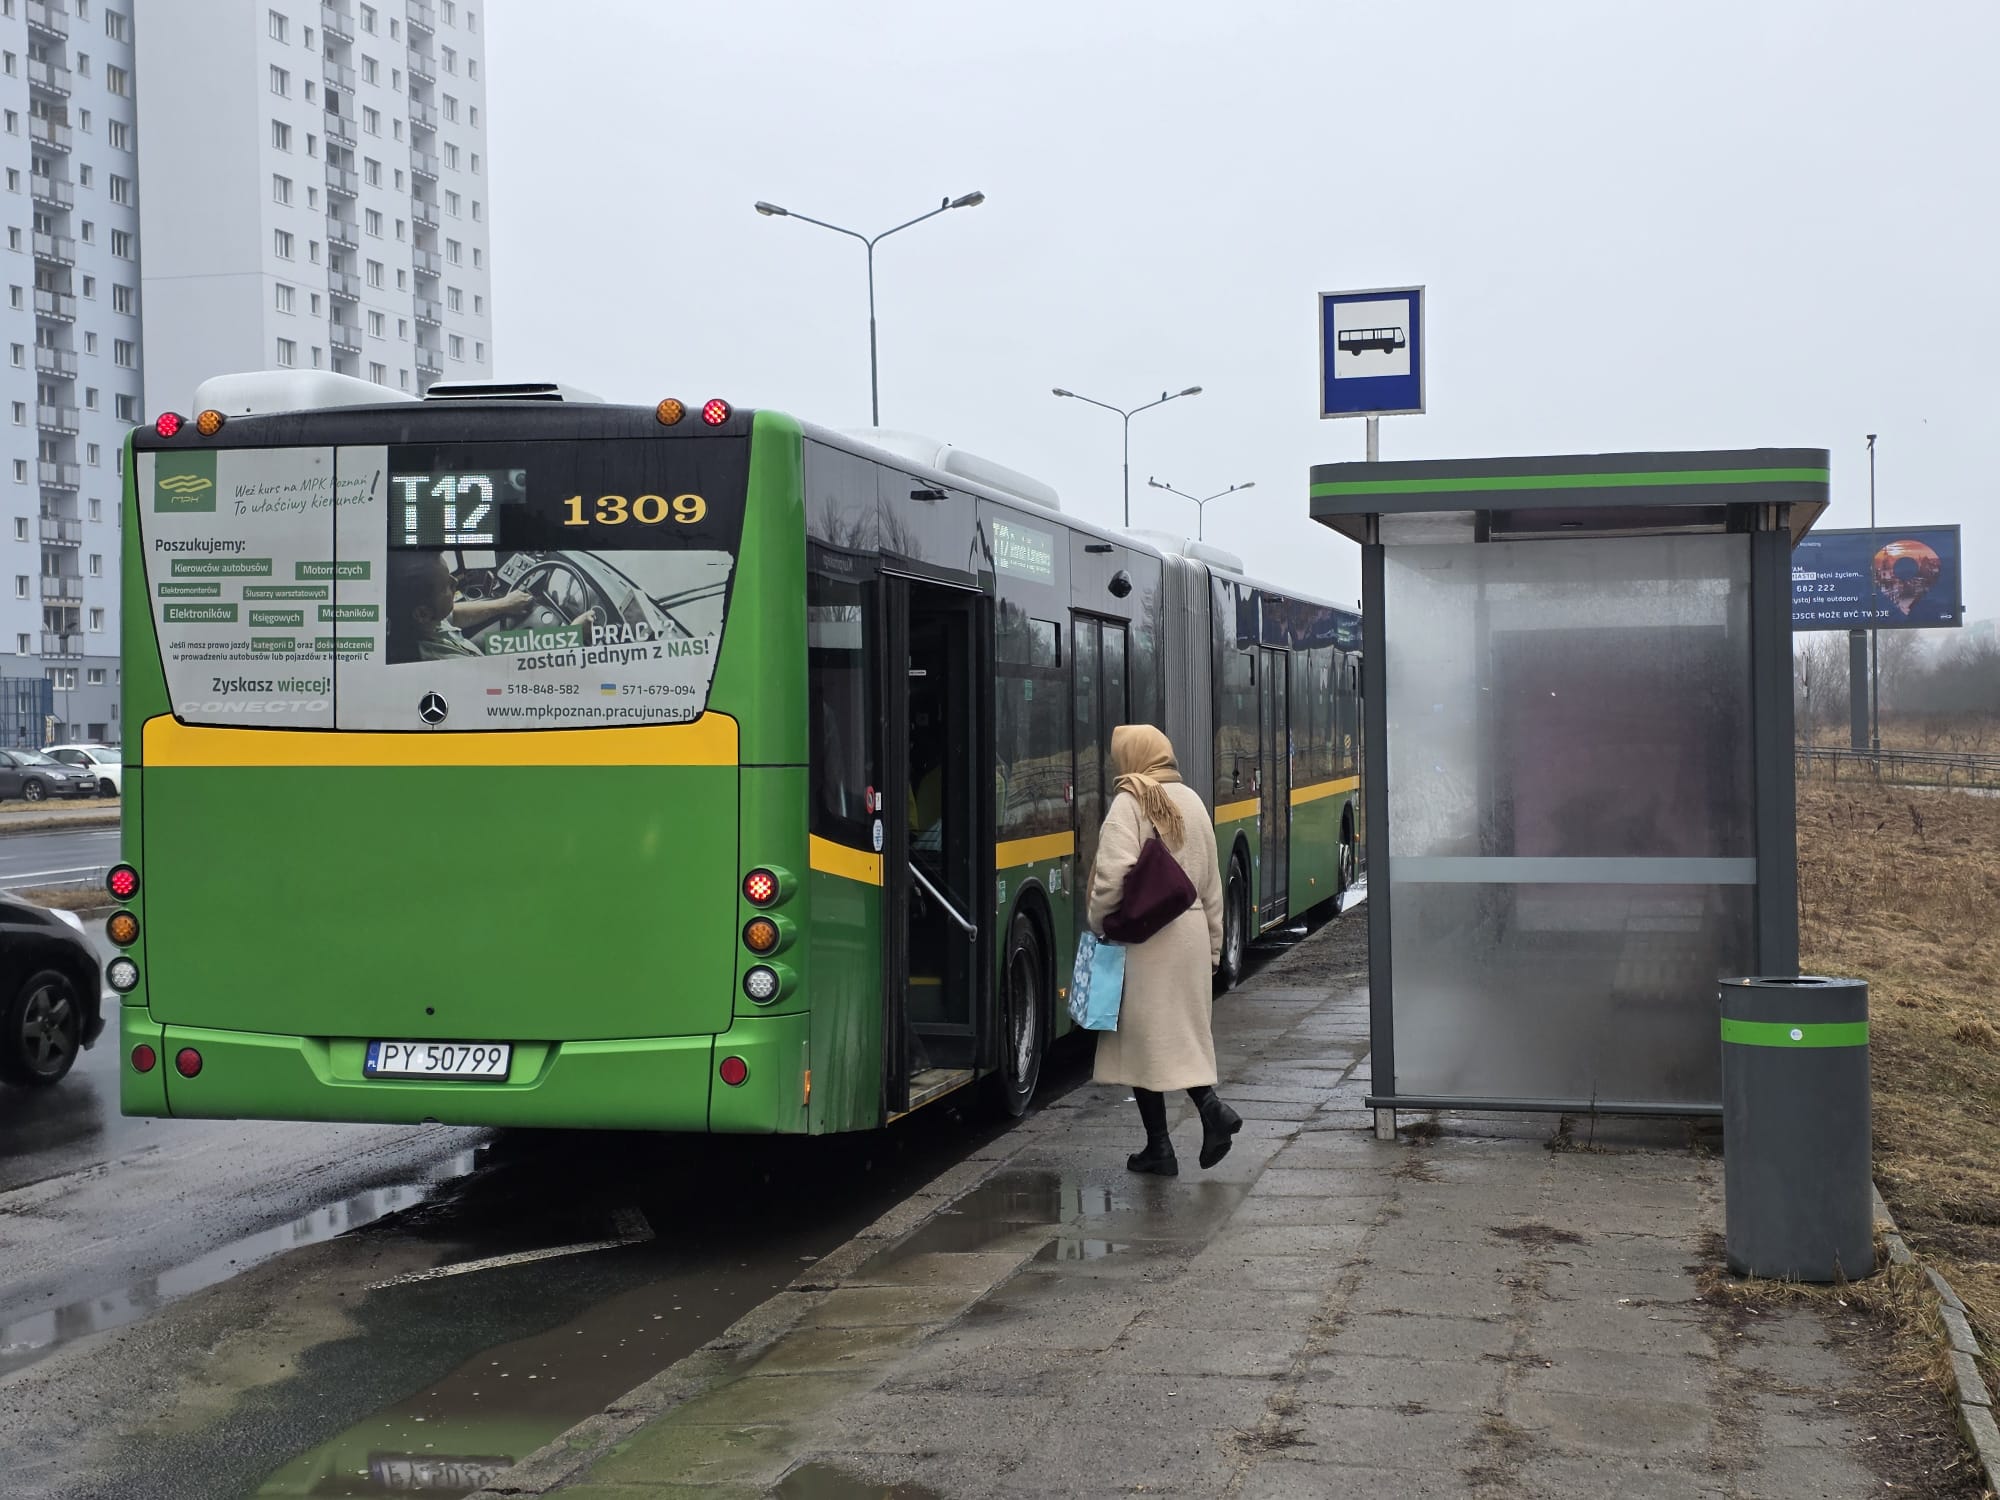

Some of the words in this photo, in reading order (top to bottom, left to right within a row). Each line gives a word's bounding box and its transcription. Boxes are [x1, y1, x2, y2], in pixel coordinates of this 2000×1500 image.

[235, 484, 256, 498] Weź
[258, 483, 280, 495] kurs
[300, 478, 328, 491] MPK
[234, 500, 247, 516] To
[251, 497, 307, 514] właściwy
[393, 474, 494, 545] T12
[563, 494, 708, 526] 1309
[155, 538, 246, 554] Poszukujemy:
[174, 563, 220, 573] Kierowców
[222, 562, 268, 573] autobusów
[160, 586, 218, 594] Elektromonterów
[1817, 584, 1836, 592] 222
[275, 590, 327, 599] warsztatowych
[1792, 596, 1811, 604] ystaj
[169, 608, 232, 619] Elektroników
[252, 613, 300, 625] Księgowych
[1818, 610, 1841, 619] MOŻE
[1843, 609, 1859, 618] BYĆ
[169, 641, 186, 649] Jeśli
[207, 642, 230, 651] prawo
[230, 641, 250, 650] jazdy
[253, 640, 286, 651] kategorii
[287, 641, 294, 649] D
[488, 629, 580, 653] Szukasz
[181, 653, 228, 662] prowadzeniu
[229, 652, 270, 661] autobusów
[271, 652, 284, 661] lub
[286, 653, 321, 662] pojazdów
[329, 653, 362, 662] ktegorii
[363, 652, 369, 661] C
[517, 651, 577, 671] zostań
[580, 646, 648, 669] jednym
[653, 646, 663, 659] z
[667, 639, 710, 658] NAS!
[212, 676, 273, 695] Zyskasz
[277, 676, 331, 696] więcej!
[507, 684, 580, 695] 518-848-582
[622, 684, 696, 696] 571-679-094
[178, 700, 330, 713] CONECTO
[486, 704, 696, 720] www.mpkpoznan.pracujunas.pl
[367, 1060, 377, 1068] PL
[383, 1044, 417, 1070] PY
[425, 1045, 502, 1073] 50799
